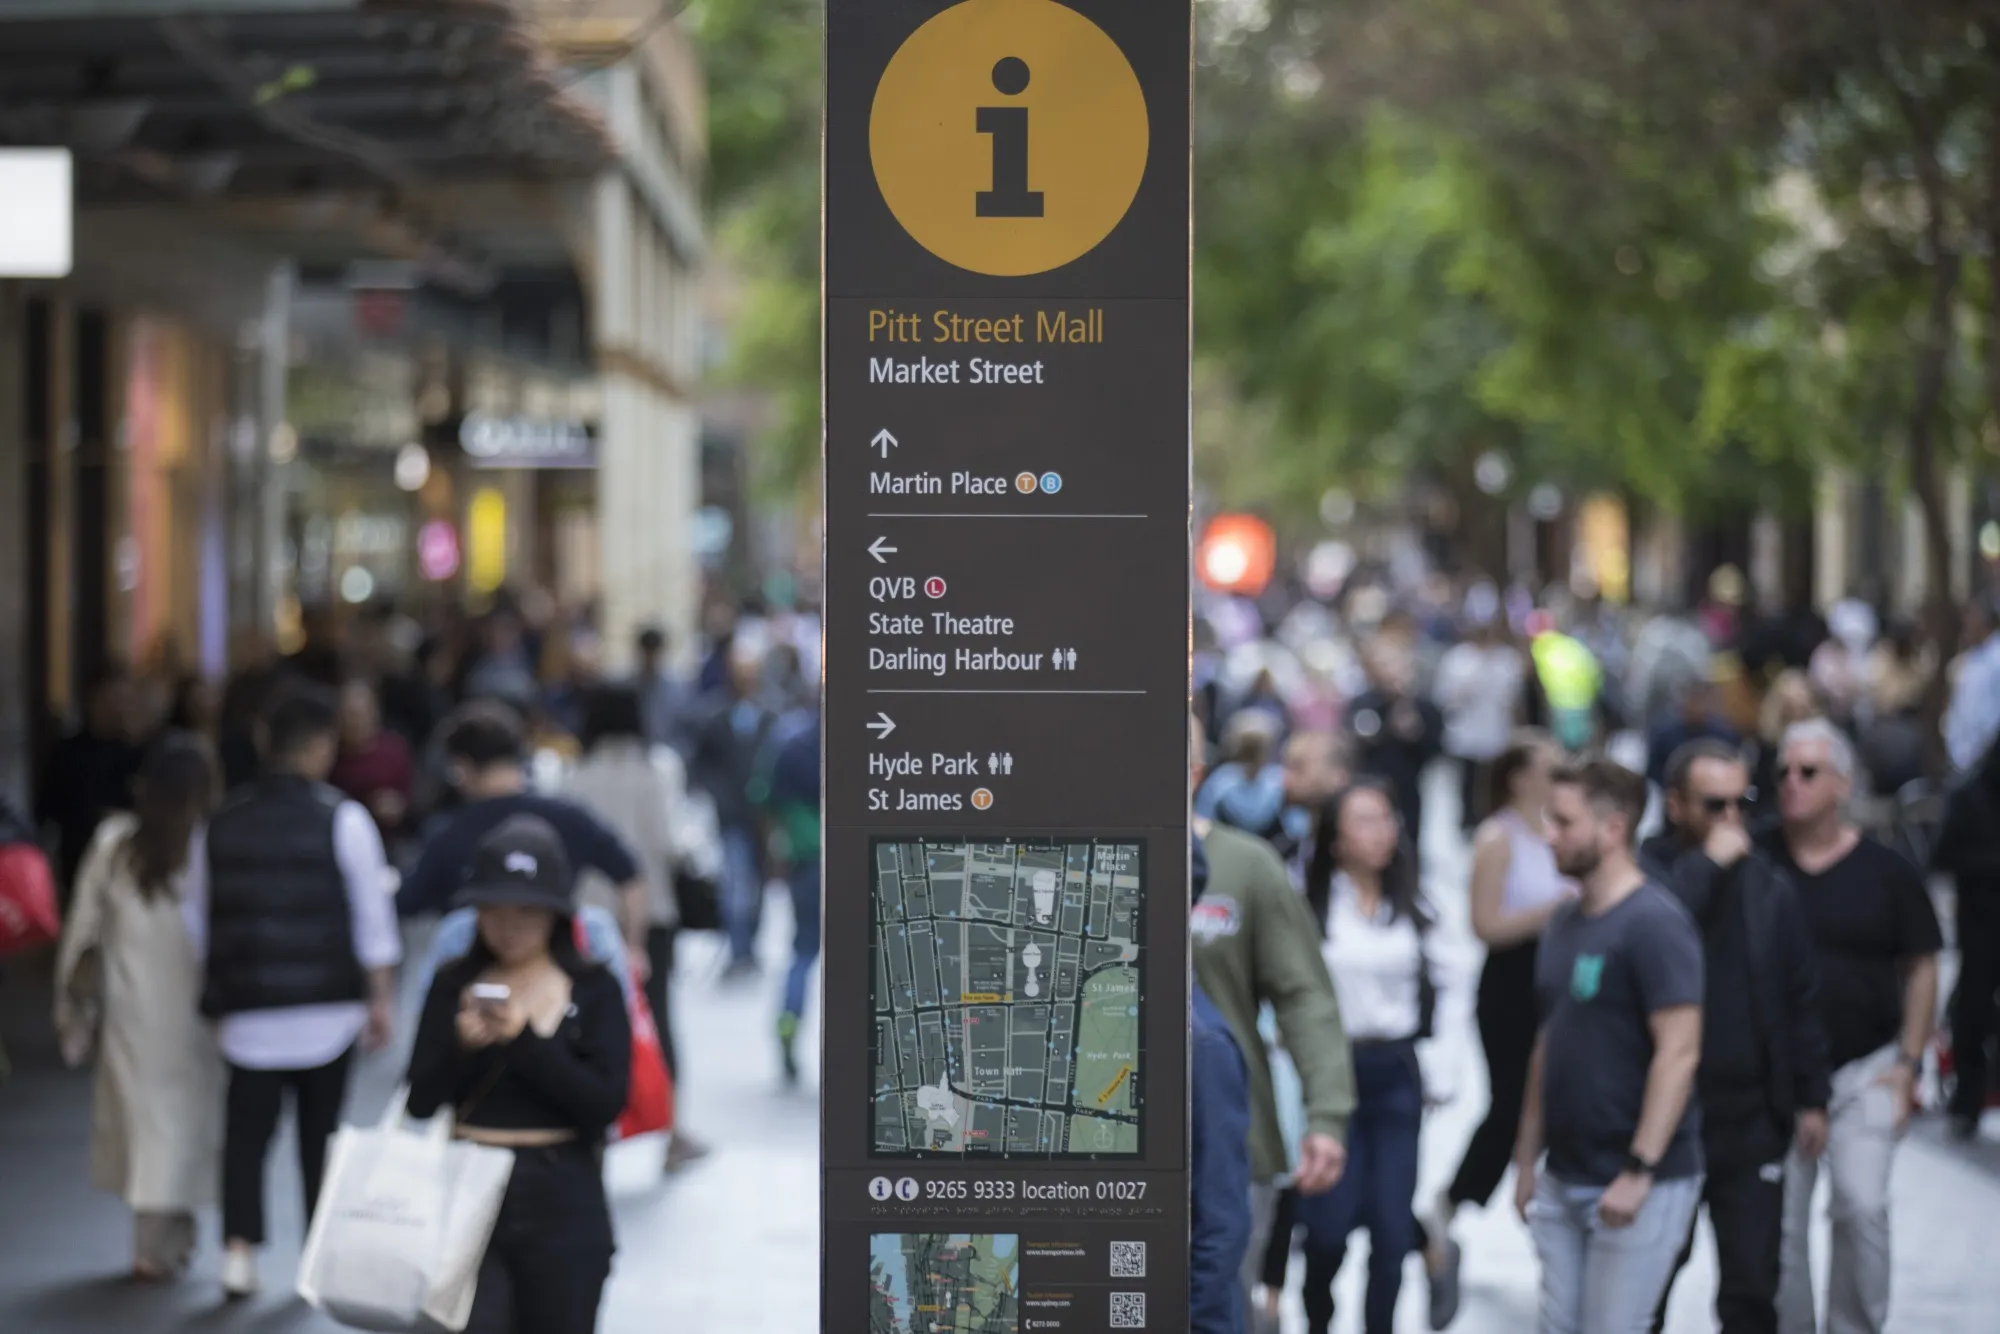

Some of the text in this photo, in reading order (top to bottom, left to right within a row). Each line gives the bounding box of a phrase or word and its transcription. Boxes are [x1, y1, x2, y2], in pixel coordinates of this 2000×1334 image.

[975, 56, 1045, 218] i
[869, 308, 1103, 343] Pitt Street Mall
[869, 356, 1044, 384] Market Street
[869, 471, 942, 494] Martin
[951, 471, 1007, 495] Place
[869, 576, 916, 602] QVB
[869, 611, 1014, 635] State Theatre
[869, 647, 1044, 676] Darling Harbour
[868, 752, 979, 780] Hyde Park
[868, 788, 889, 811] St
[895, 788, 963, 811] James
[1097, 851, 1130, 861] Martin
[1092, 983, 1102, 992] St
[974, 1066, 999, 1076] Town
[926, 1180, 967, 1199] 9265
[974, 1180, 1015, 1199] 9333
[1022, 1180, 1090, 1200] location
[1096, 1181, 1147, 1200] 01027
